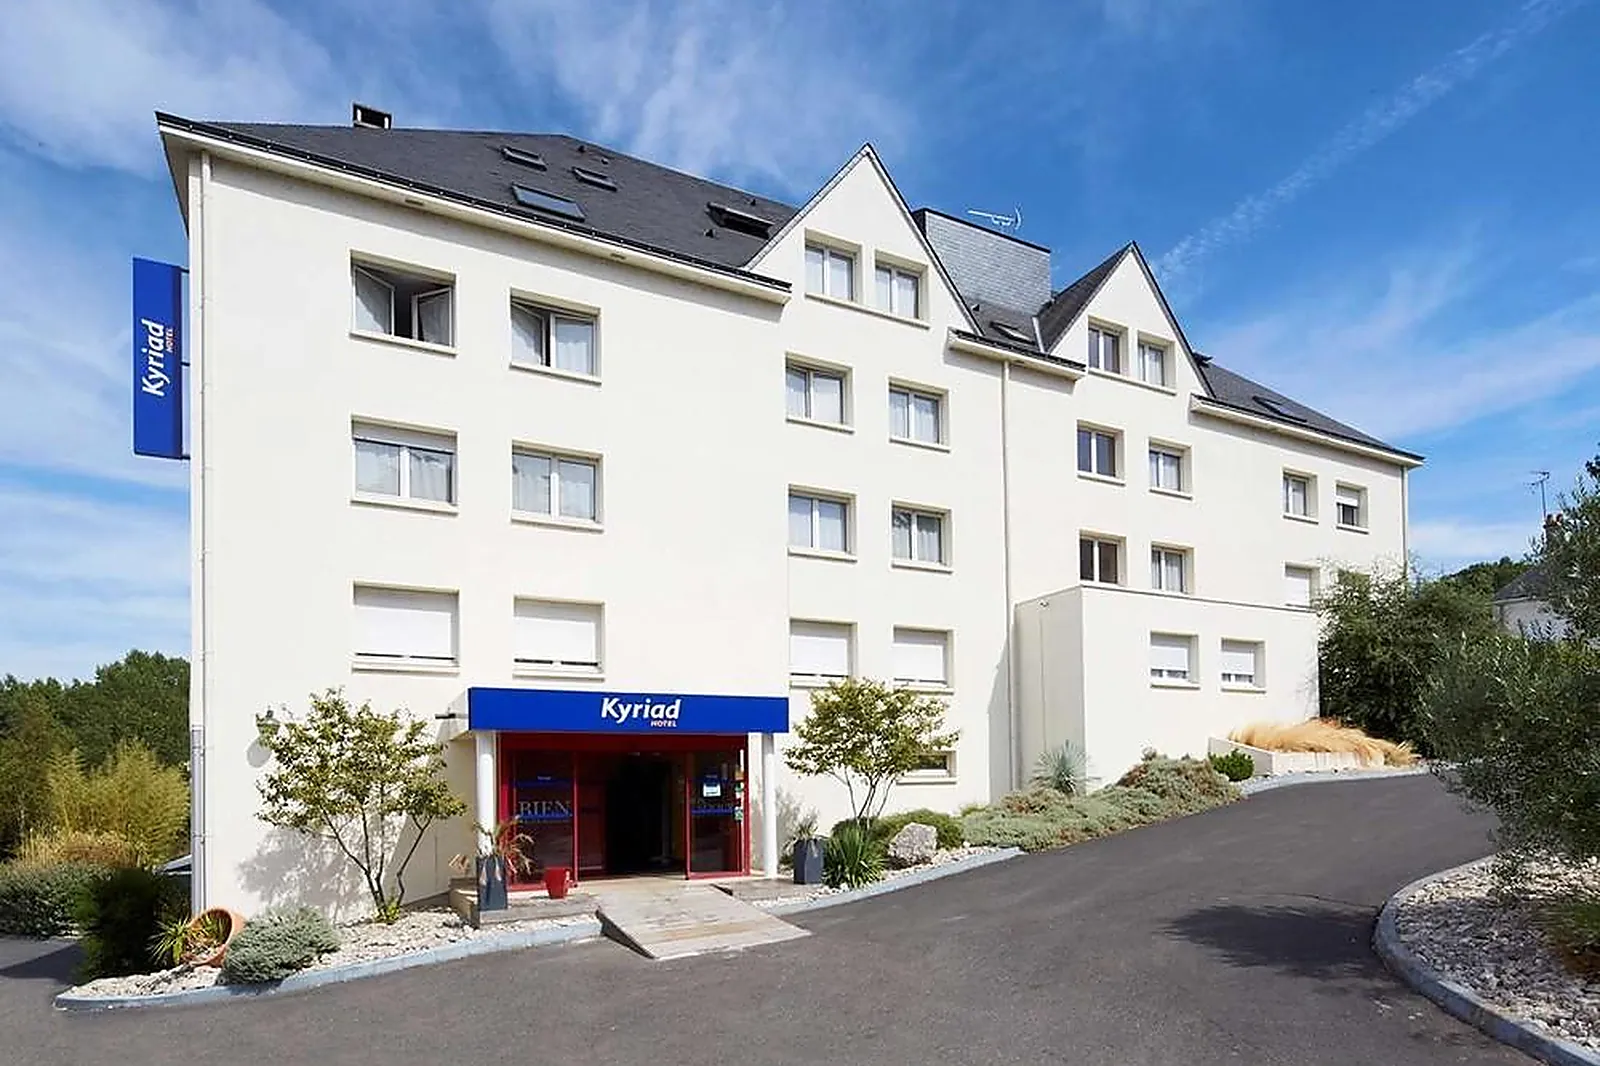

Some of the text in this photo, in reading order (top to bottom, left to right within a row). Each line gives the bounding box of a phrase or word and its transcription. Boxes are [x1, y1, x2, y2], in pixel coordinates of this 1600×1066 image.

[141, 318, 170, 397] Kyriad
[601, 697, 682, 724] Kyriad
[650, 719, 677, 727] HOTEL
